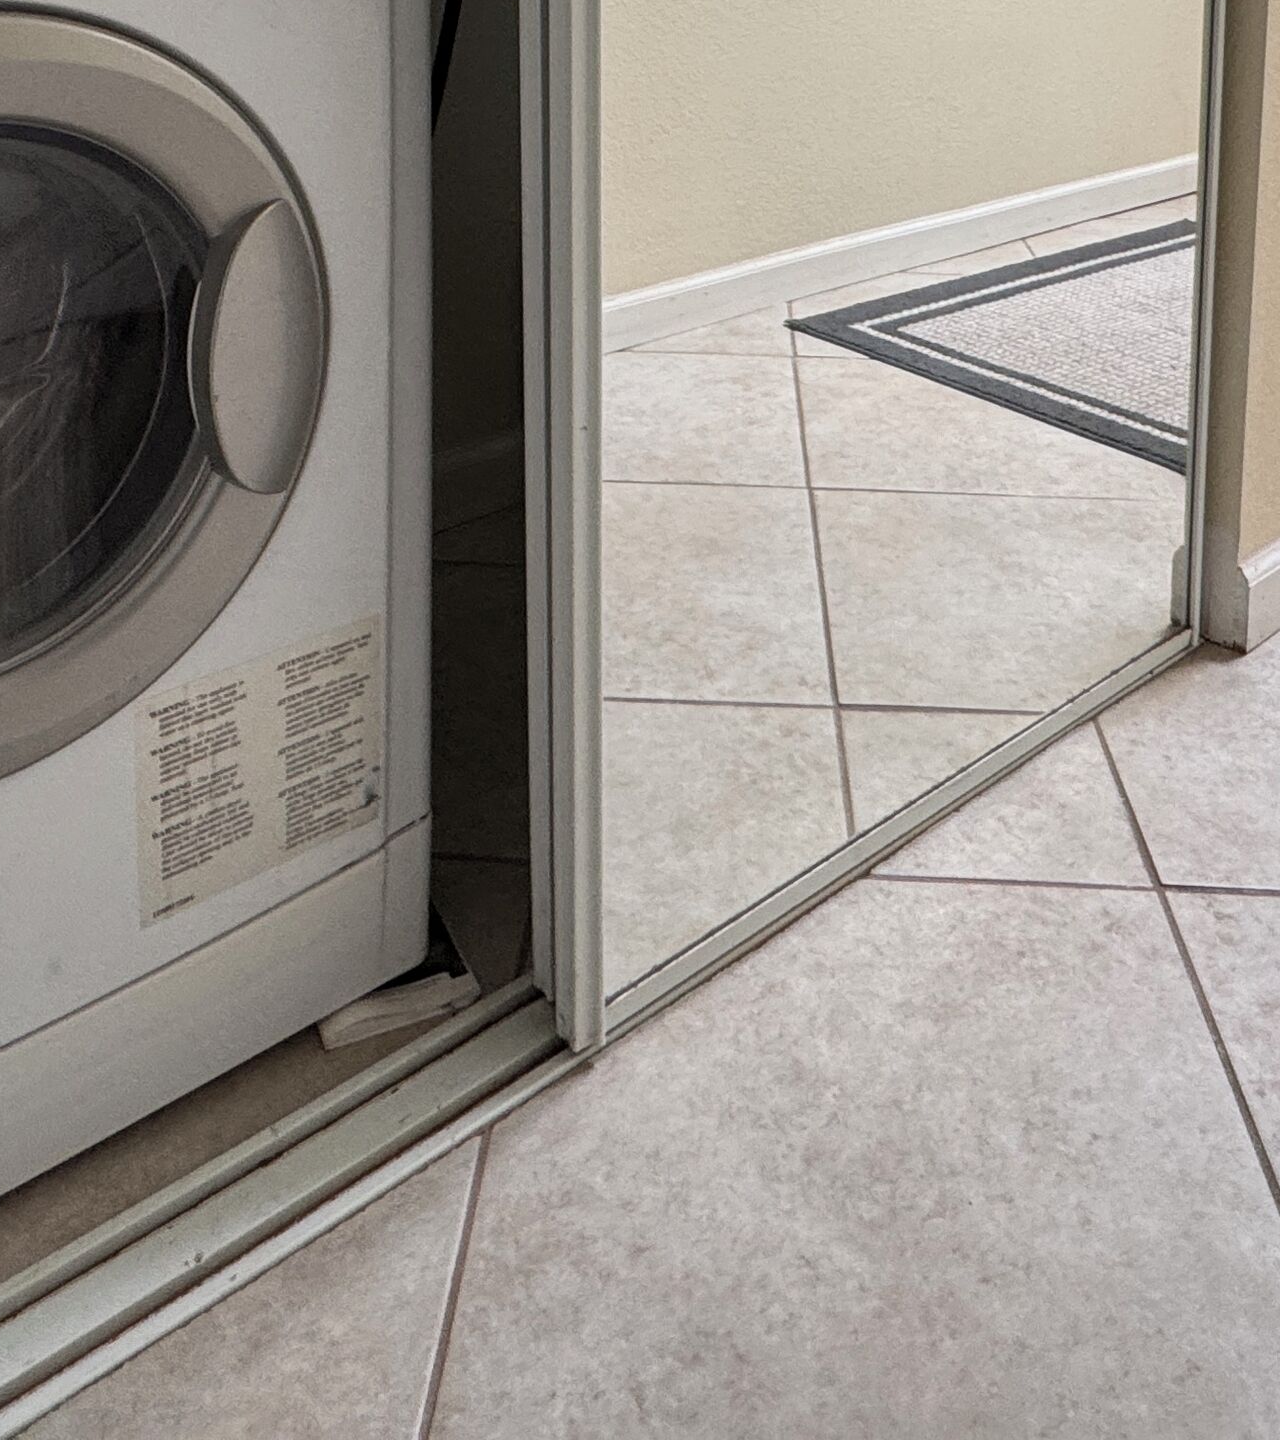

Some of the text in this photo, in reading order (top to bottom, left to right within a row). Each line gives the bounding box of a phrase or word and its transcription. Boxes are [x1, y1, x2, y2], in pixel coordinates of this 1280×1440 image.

[276, 650, 321, 672] ATTENTION
[277, 686, 321, 707] ATTENTION
[148, 699, 191, 720] WARNING
[150, 736, 191, 757] WARNING
[150, 780, 192, 803] WARNING
[151, 817, 192, 841] WARNING
